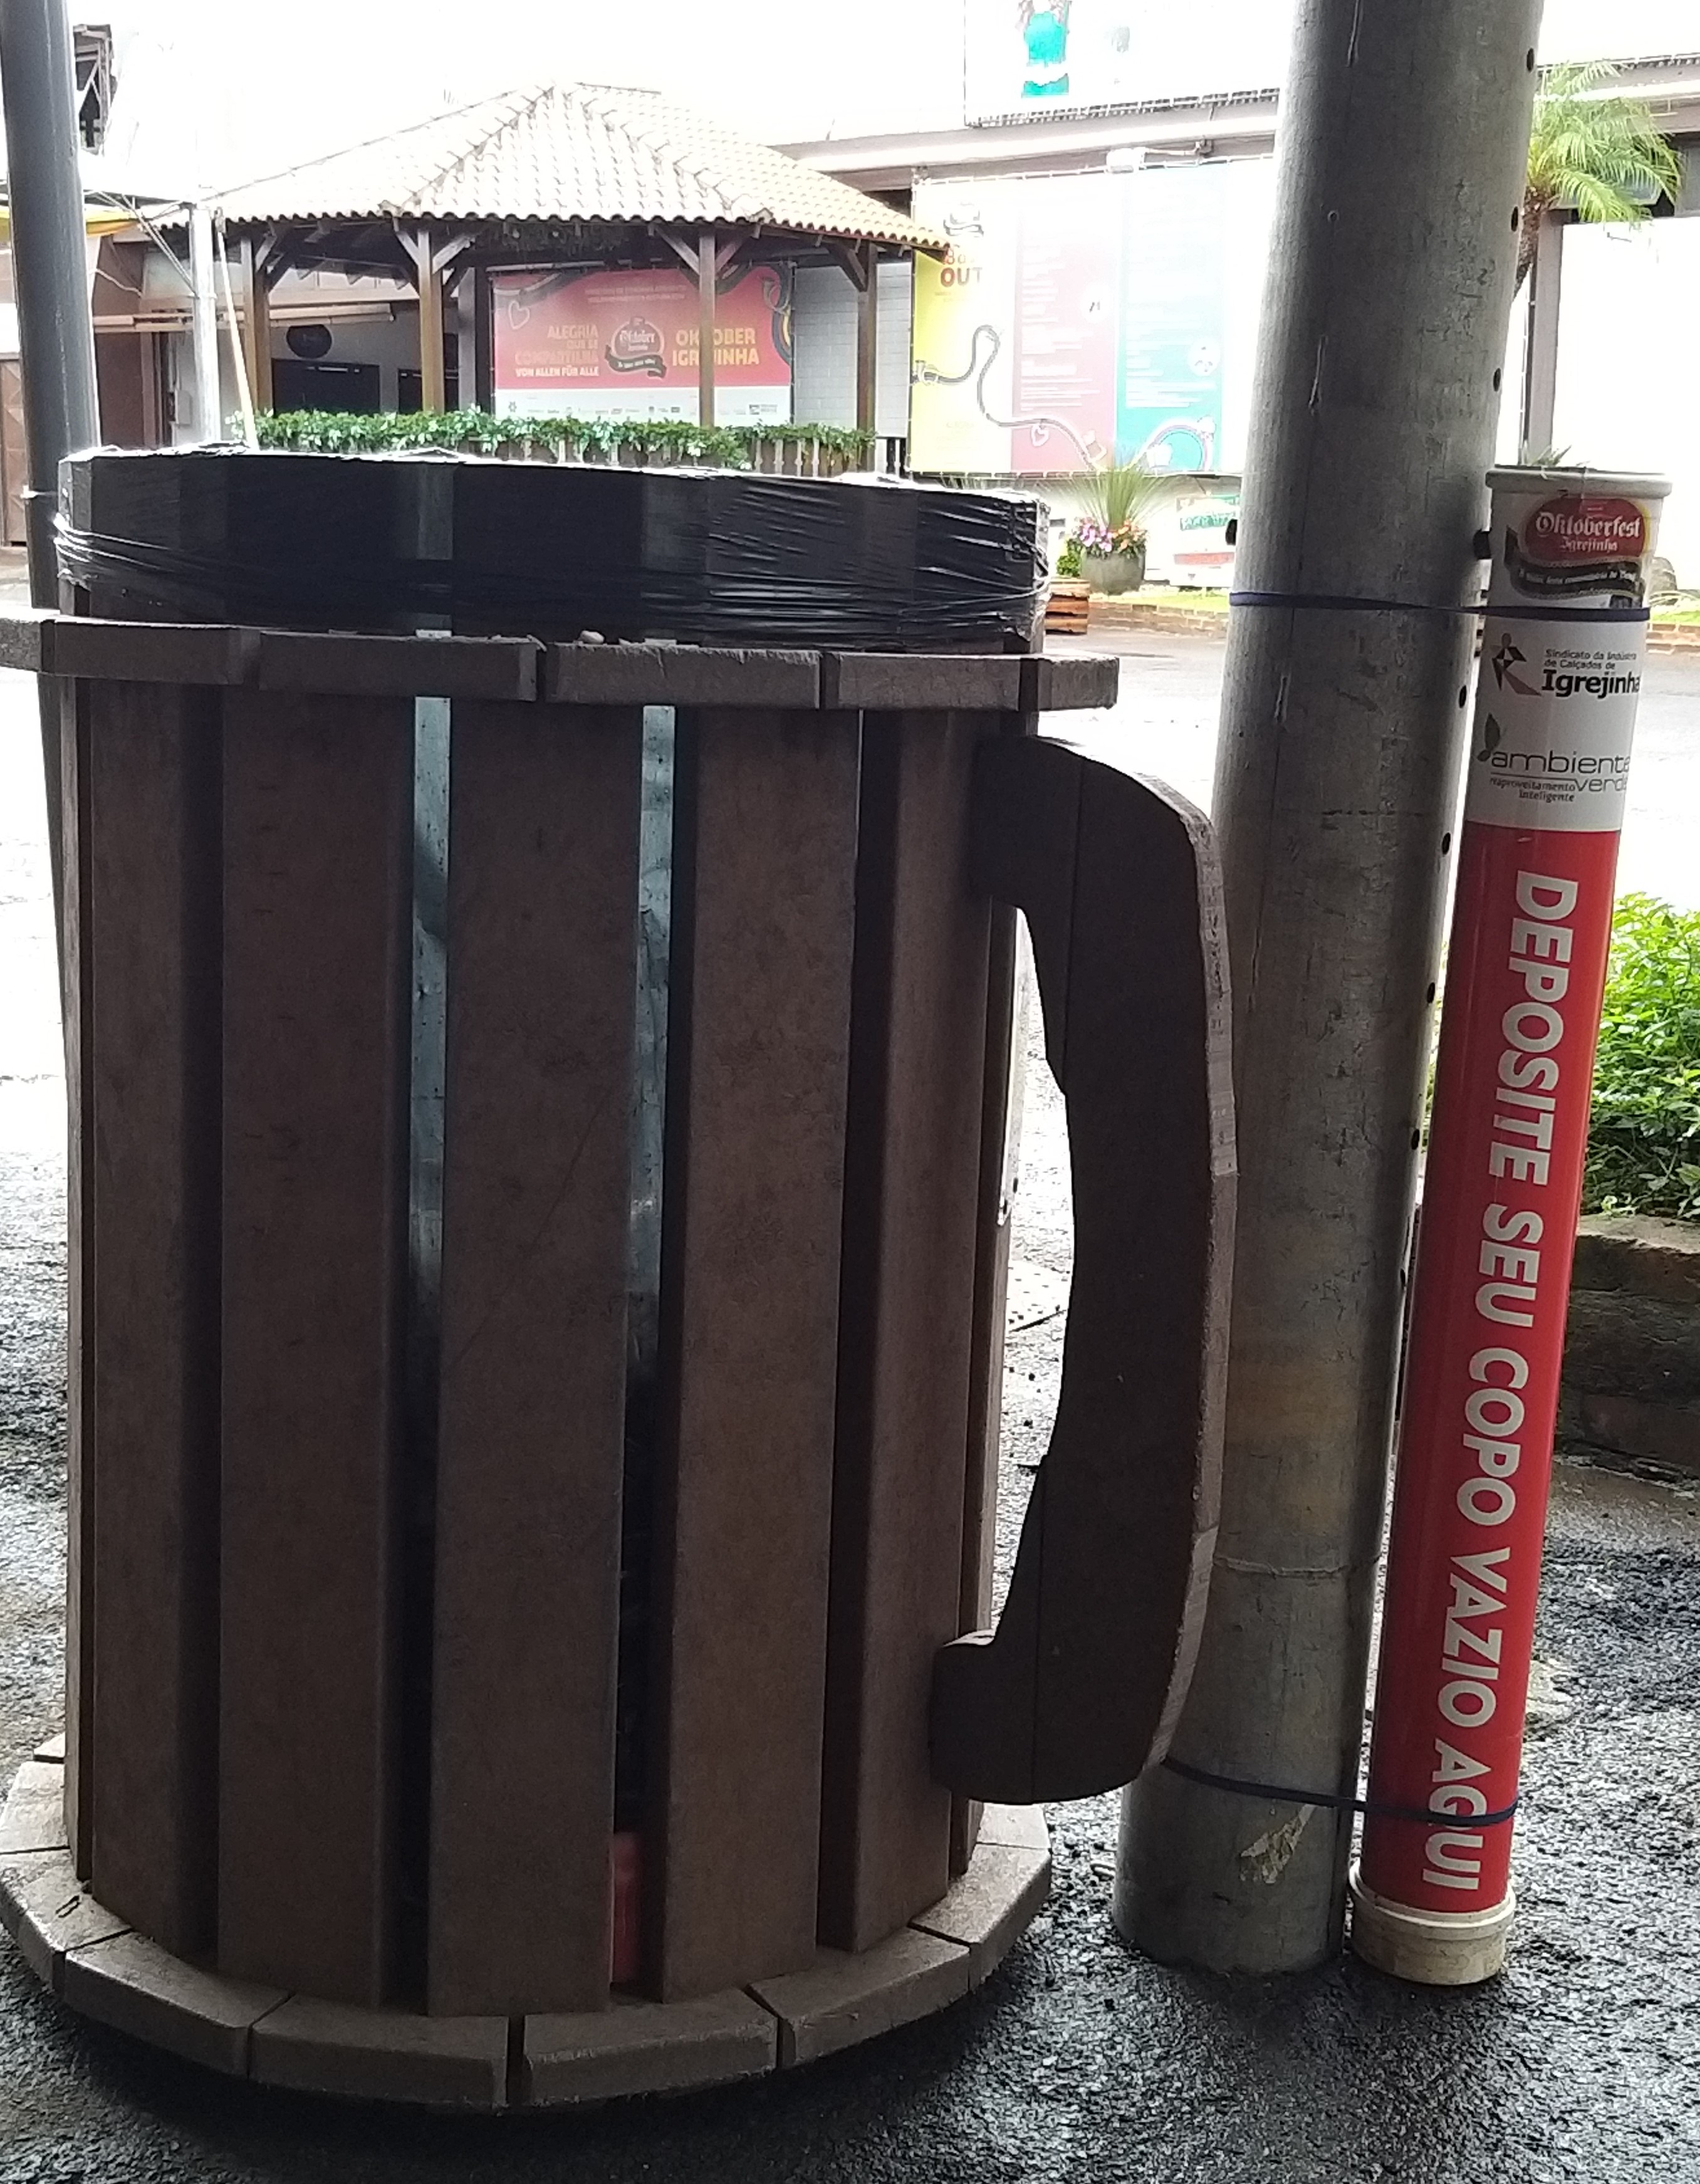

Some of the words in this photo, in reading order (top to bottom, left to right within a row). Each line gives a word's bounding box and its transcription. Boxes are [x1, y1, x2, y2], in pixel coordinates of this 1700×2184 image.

[675, 328, 756, 346] OKOBER
[1536, 511, 1641, 537] Oktoberfest
[1545, 659, 1557, 667] de
[1560, 659, 1602, 670] Calçados
[1605, 662, 1615, 670] de
[1546, 649, 1590, 659] Sindicato
[1593, 651, 1604, 660] da
[1542, 669, 1640, 699] Igrejinha
[1488, 870, 1578, 1186] DEPOSITE
[1474, 1203, 1546, 1328] SEU
[1456, 1347, 1530, 1527] COPO
[1438, 1547, 1510, 1728] VAZIO
